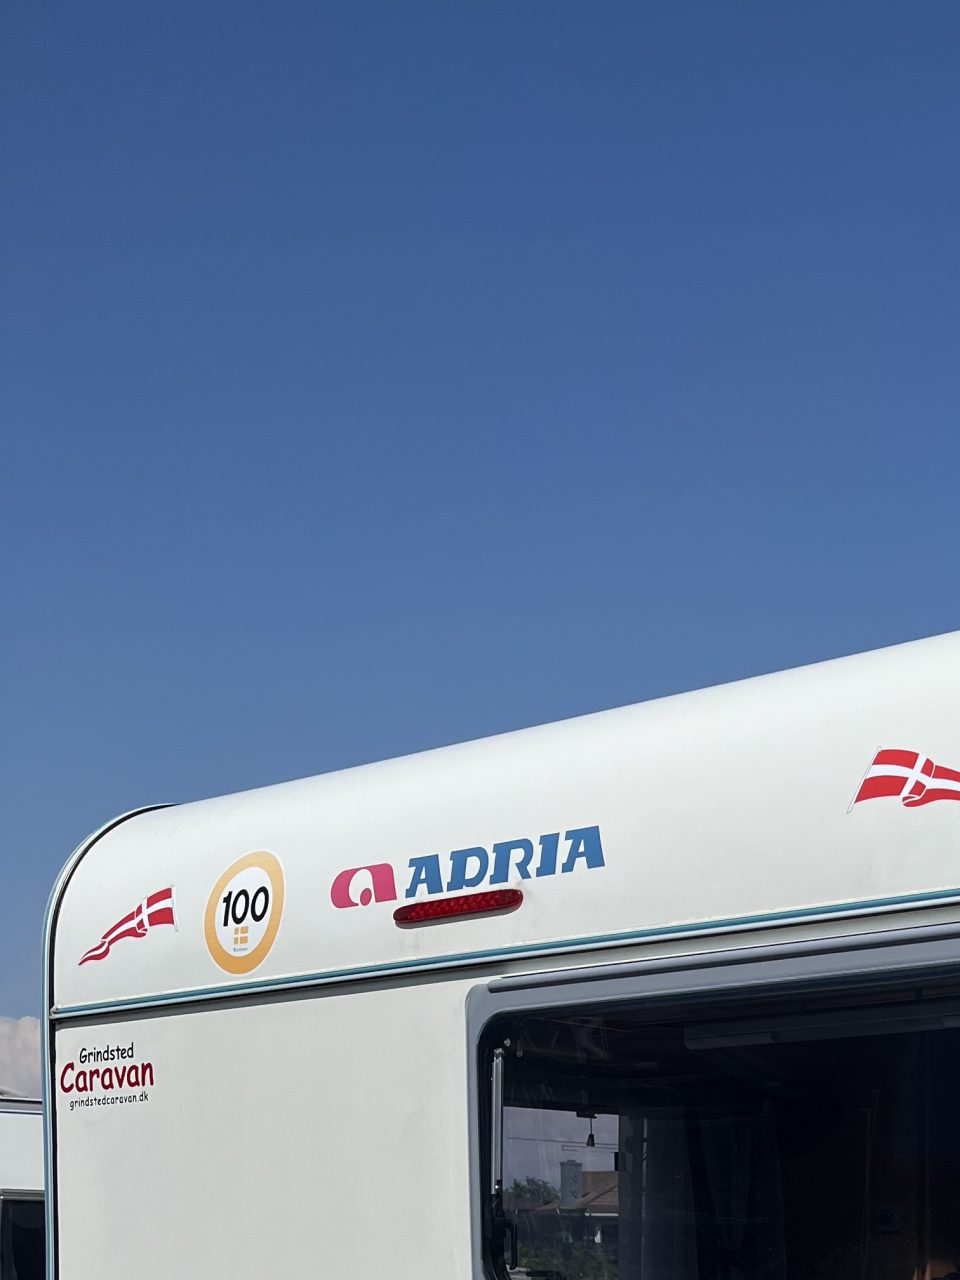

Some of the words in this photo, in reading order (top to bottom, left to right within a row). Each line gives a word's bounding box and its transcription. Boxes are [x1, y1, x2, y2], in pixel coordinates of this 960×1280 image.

[404, 825, 606, 899] ADRIA
[222, 886, 270, 927] 100
[79, 1041, 134, 1064] Grindsted
[60, 1062, 154, 1093] Caravan
[69, 1091, 149, 1111] grindstedcaravan.dk
